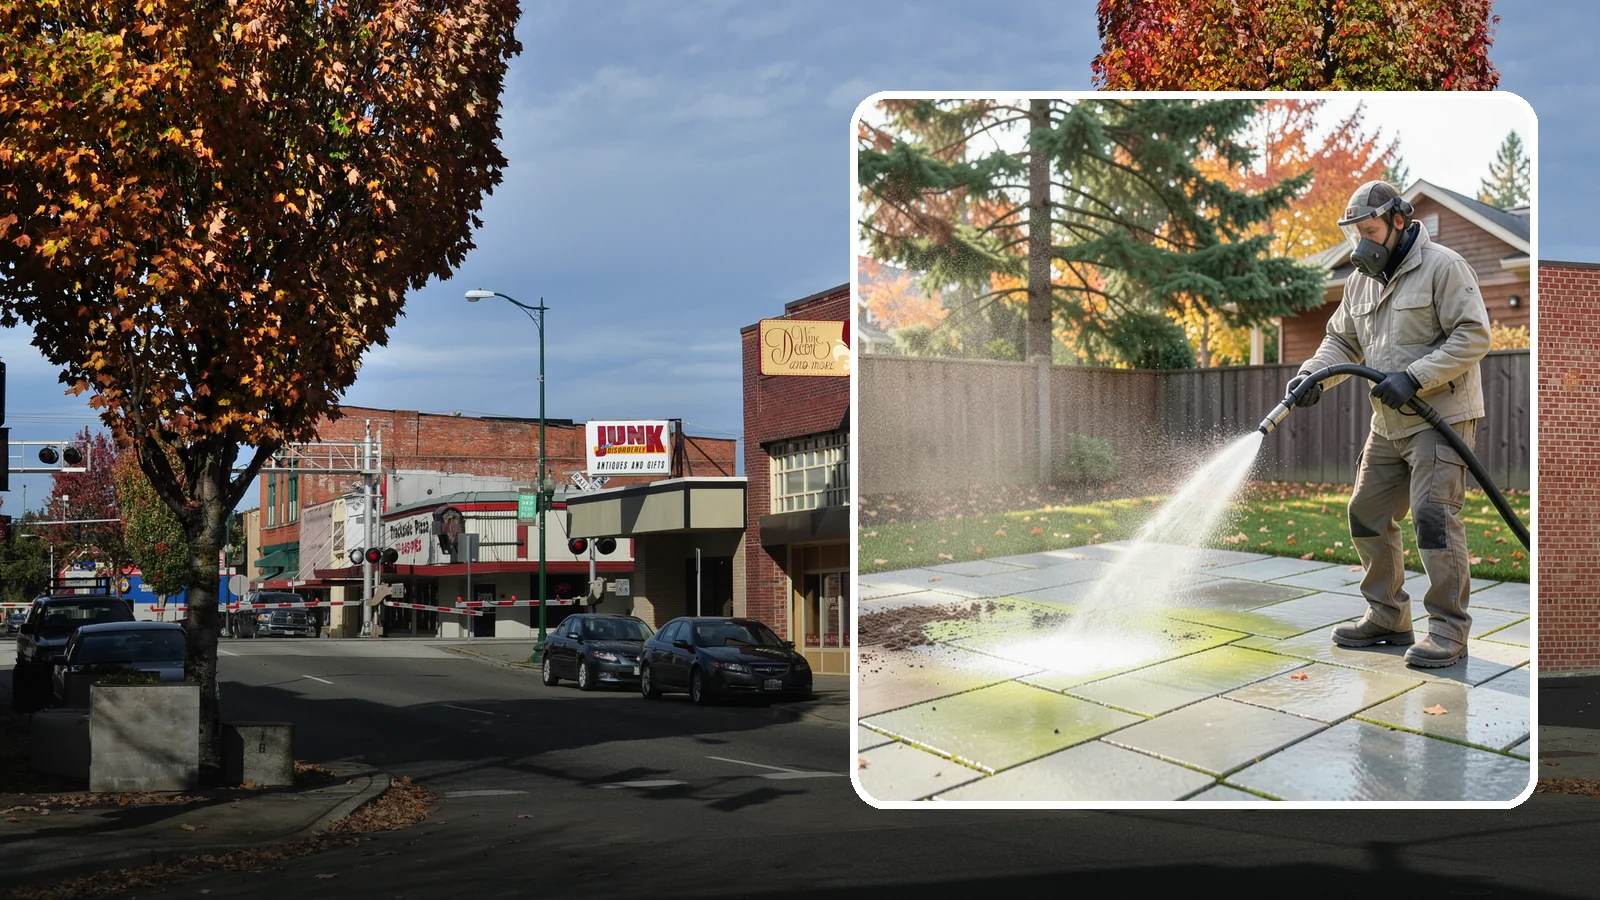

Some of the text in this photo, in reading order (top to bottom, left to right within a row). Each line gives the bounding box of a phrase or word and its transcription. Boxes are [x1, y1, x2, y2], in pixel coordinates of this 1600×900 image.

[765, 328, 831, 365] Decor
[595, 425, 665, 457] JUNK
[607, 446, 646, 454] DISORDERLY
[597, 460, 665, 470] ANTIQUES AND GIFTS
[390, 519, 429, 539] Trackside Pizza
